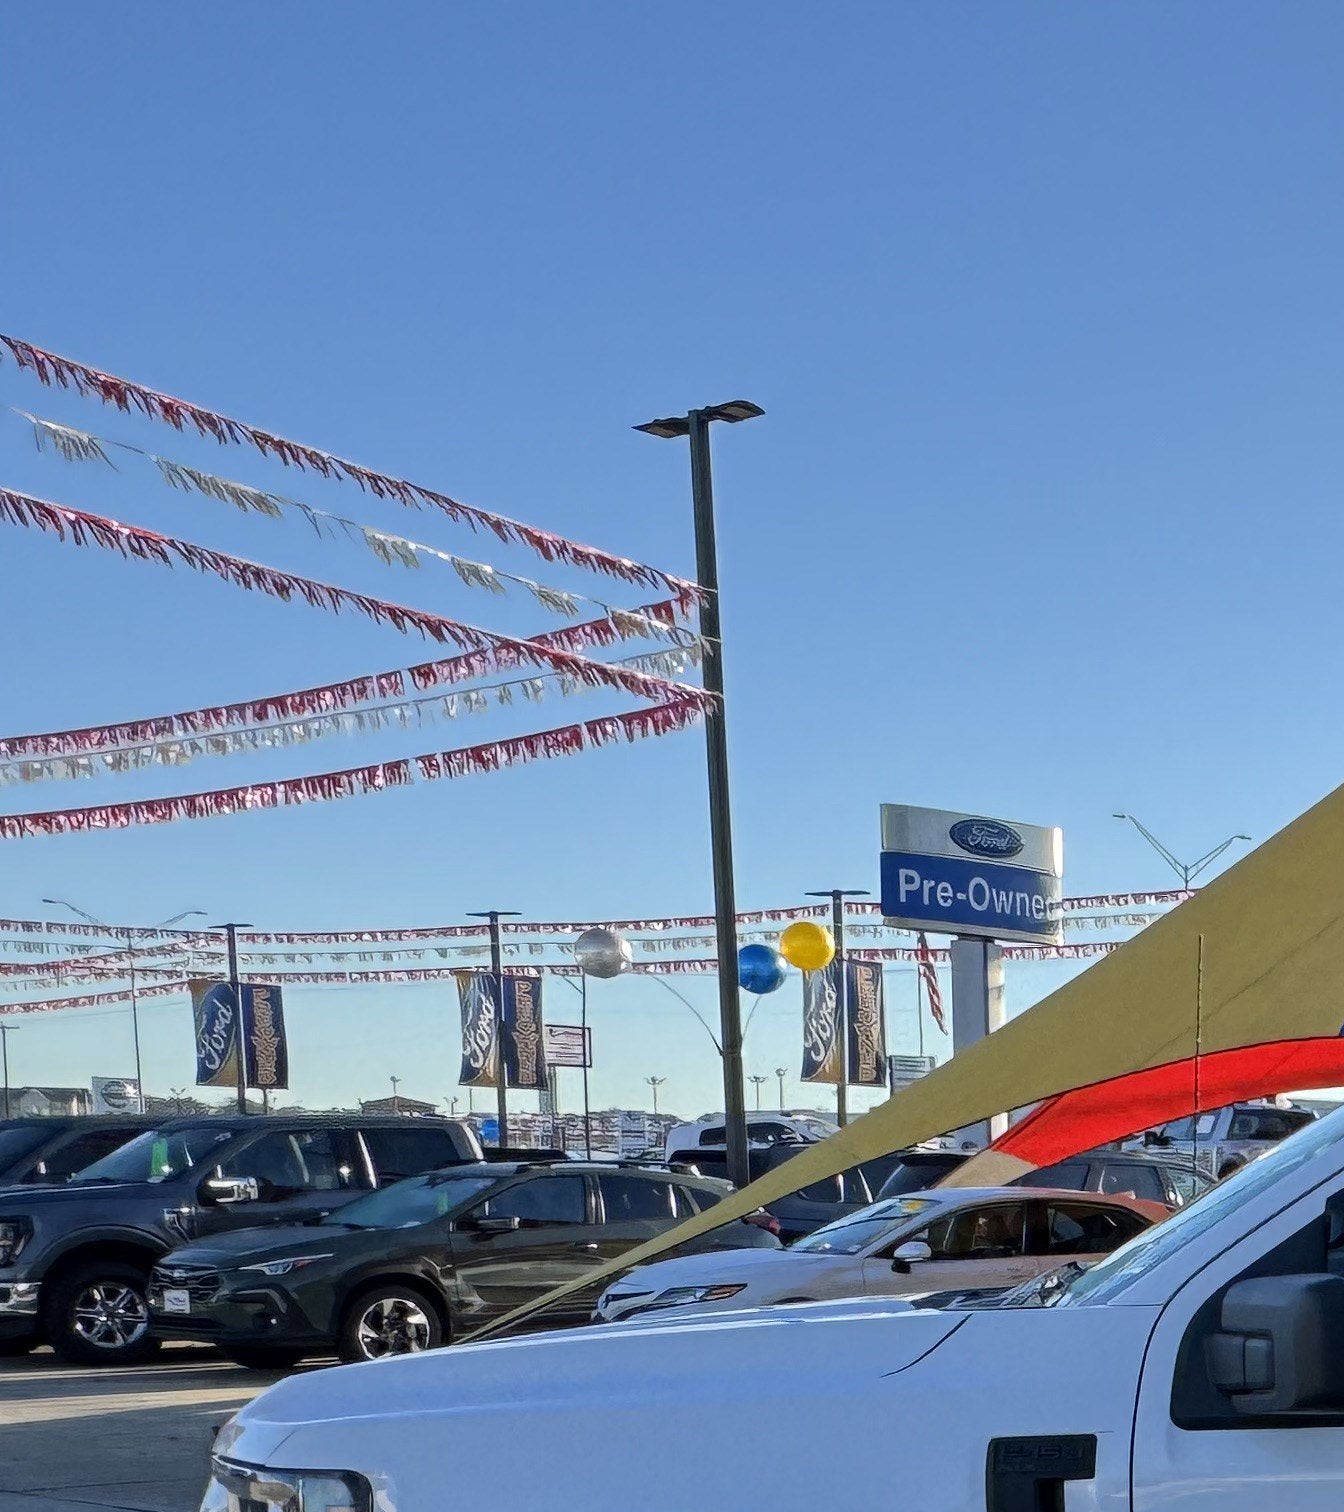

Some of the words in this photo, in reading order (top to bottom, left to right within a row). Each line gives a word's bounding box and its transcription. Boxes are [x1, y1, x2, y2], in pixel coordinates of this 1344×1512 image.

[967, 825, 1010, 851] Ford
[197, 999, 234, 1070] Ford
[462, 993, 496, 1068] Ford
